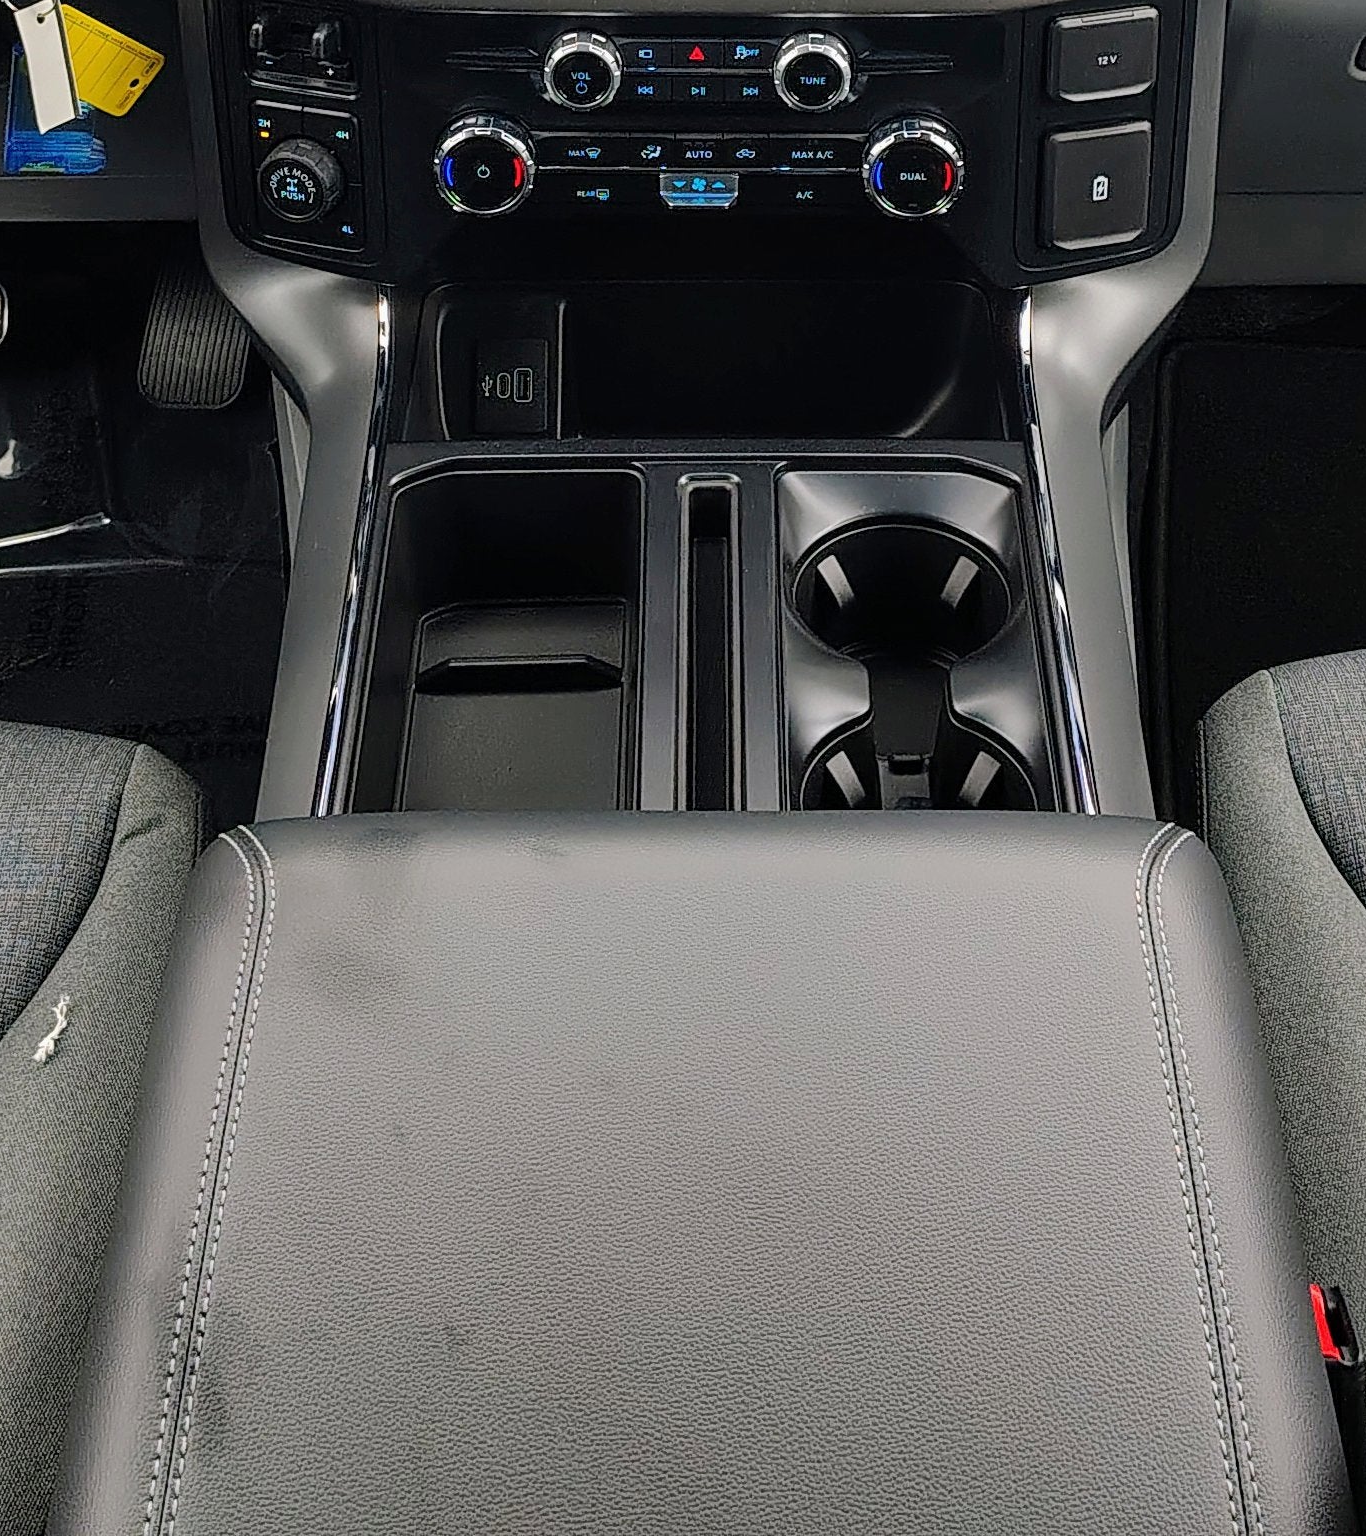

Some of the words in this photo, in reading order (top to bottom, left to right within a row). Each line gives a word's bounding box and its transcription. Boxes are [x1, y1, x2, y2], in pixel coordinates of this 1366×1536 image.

[746, 48, 760, 57] OFF
[1097, 56, 1108, 65] 12
[1110, 55, 1118, 64] V
[571, 72, 591, 80] VOL
[799, 76, 827, 85] TUNE
[257, 119, 270, 128] 2H
[335, 130, 349, 139] 4H
[568, 149, 585, 157] MAX
[685, 150, 713, 159] AUTO
[791, 150, 814, 159] MAX
[816, 150, 834, 160] A/C
[269, 167, 290, 187] DRIVE
[292, 168, 316, 193] MODE
[900, 172, 927, 181] DUAL
[280, 190, 305, 201] PUSH
[796, 190, 814, 200] A/C
[341, 225, 354, 234] 4L
